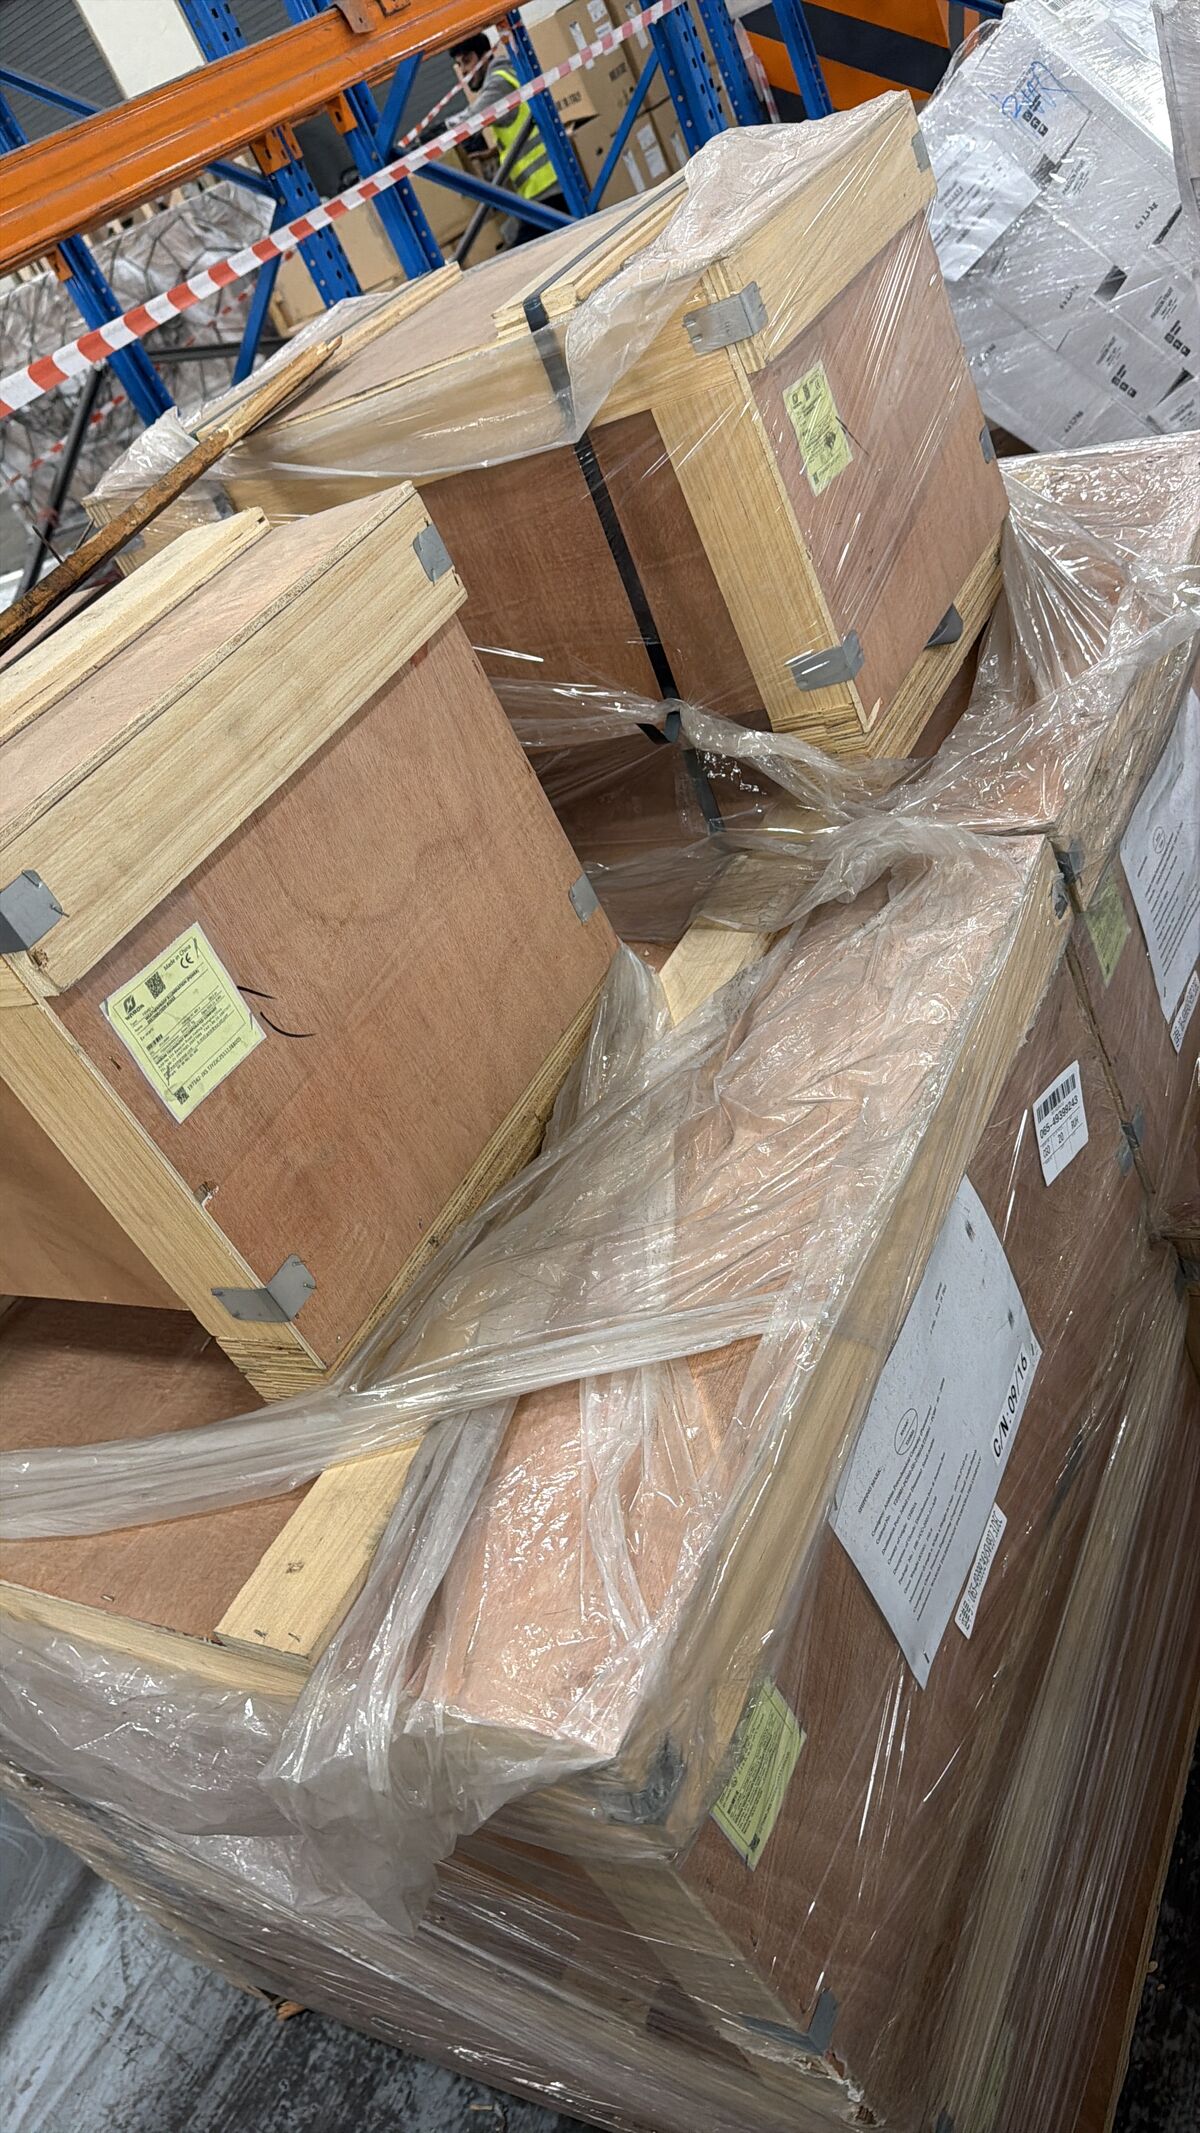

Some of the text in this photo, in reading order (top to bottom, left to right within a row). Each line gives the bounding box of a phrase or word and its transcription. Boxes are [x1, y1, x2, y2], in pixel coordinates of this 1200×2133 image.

[163, 958, 175, 970] Made
[178, 943, 191, 956] China
[993, 1355, 1028, 1459] C/N:09/16
